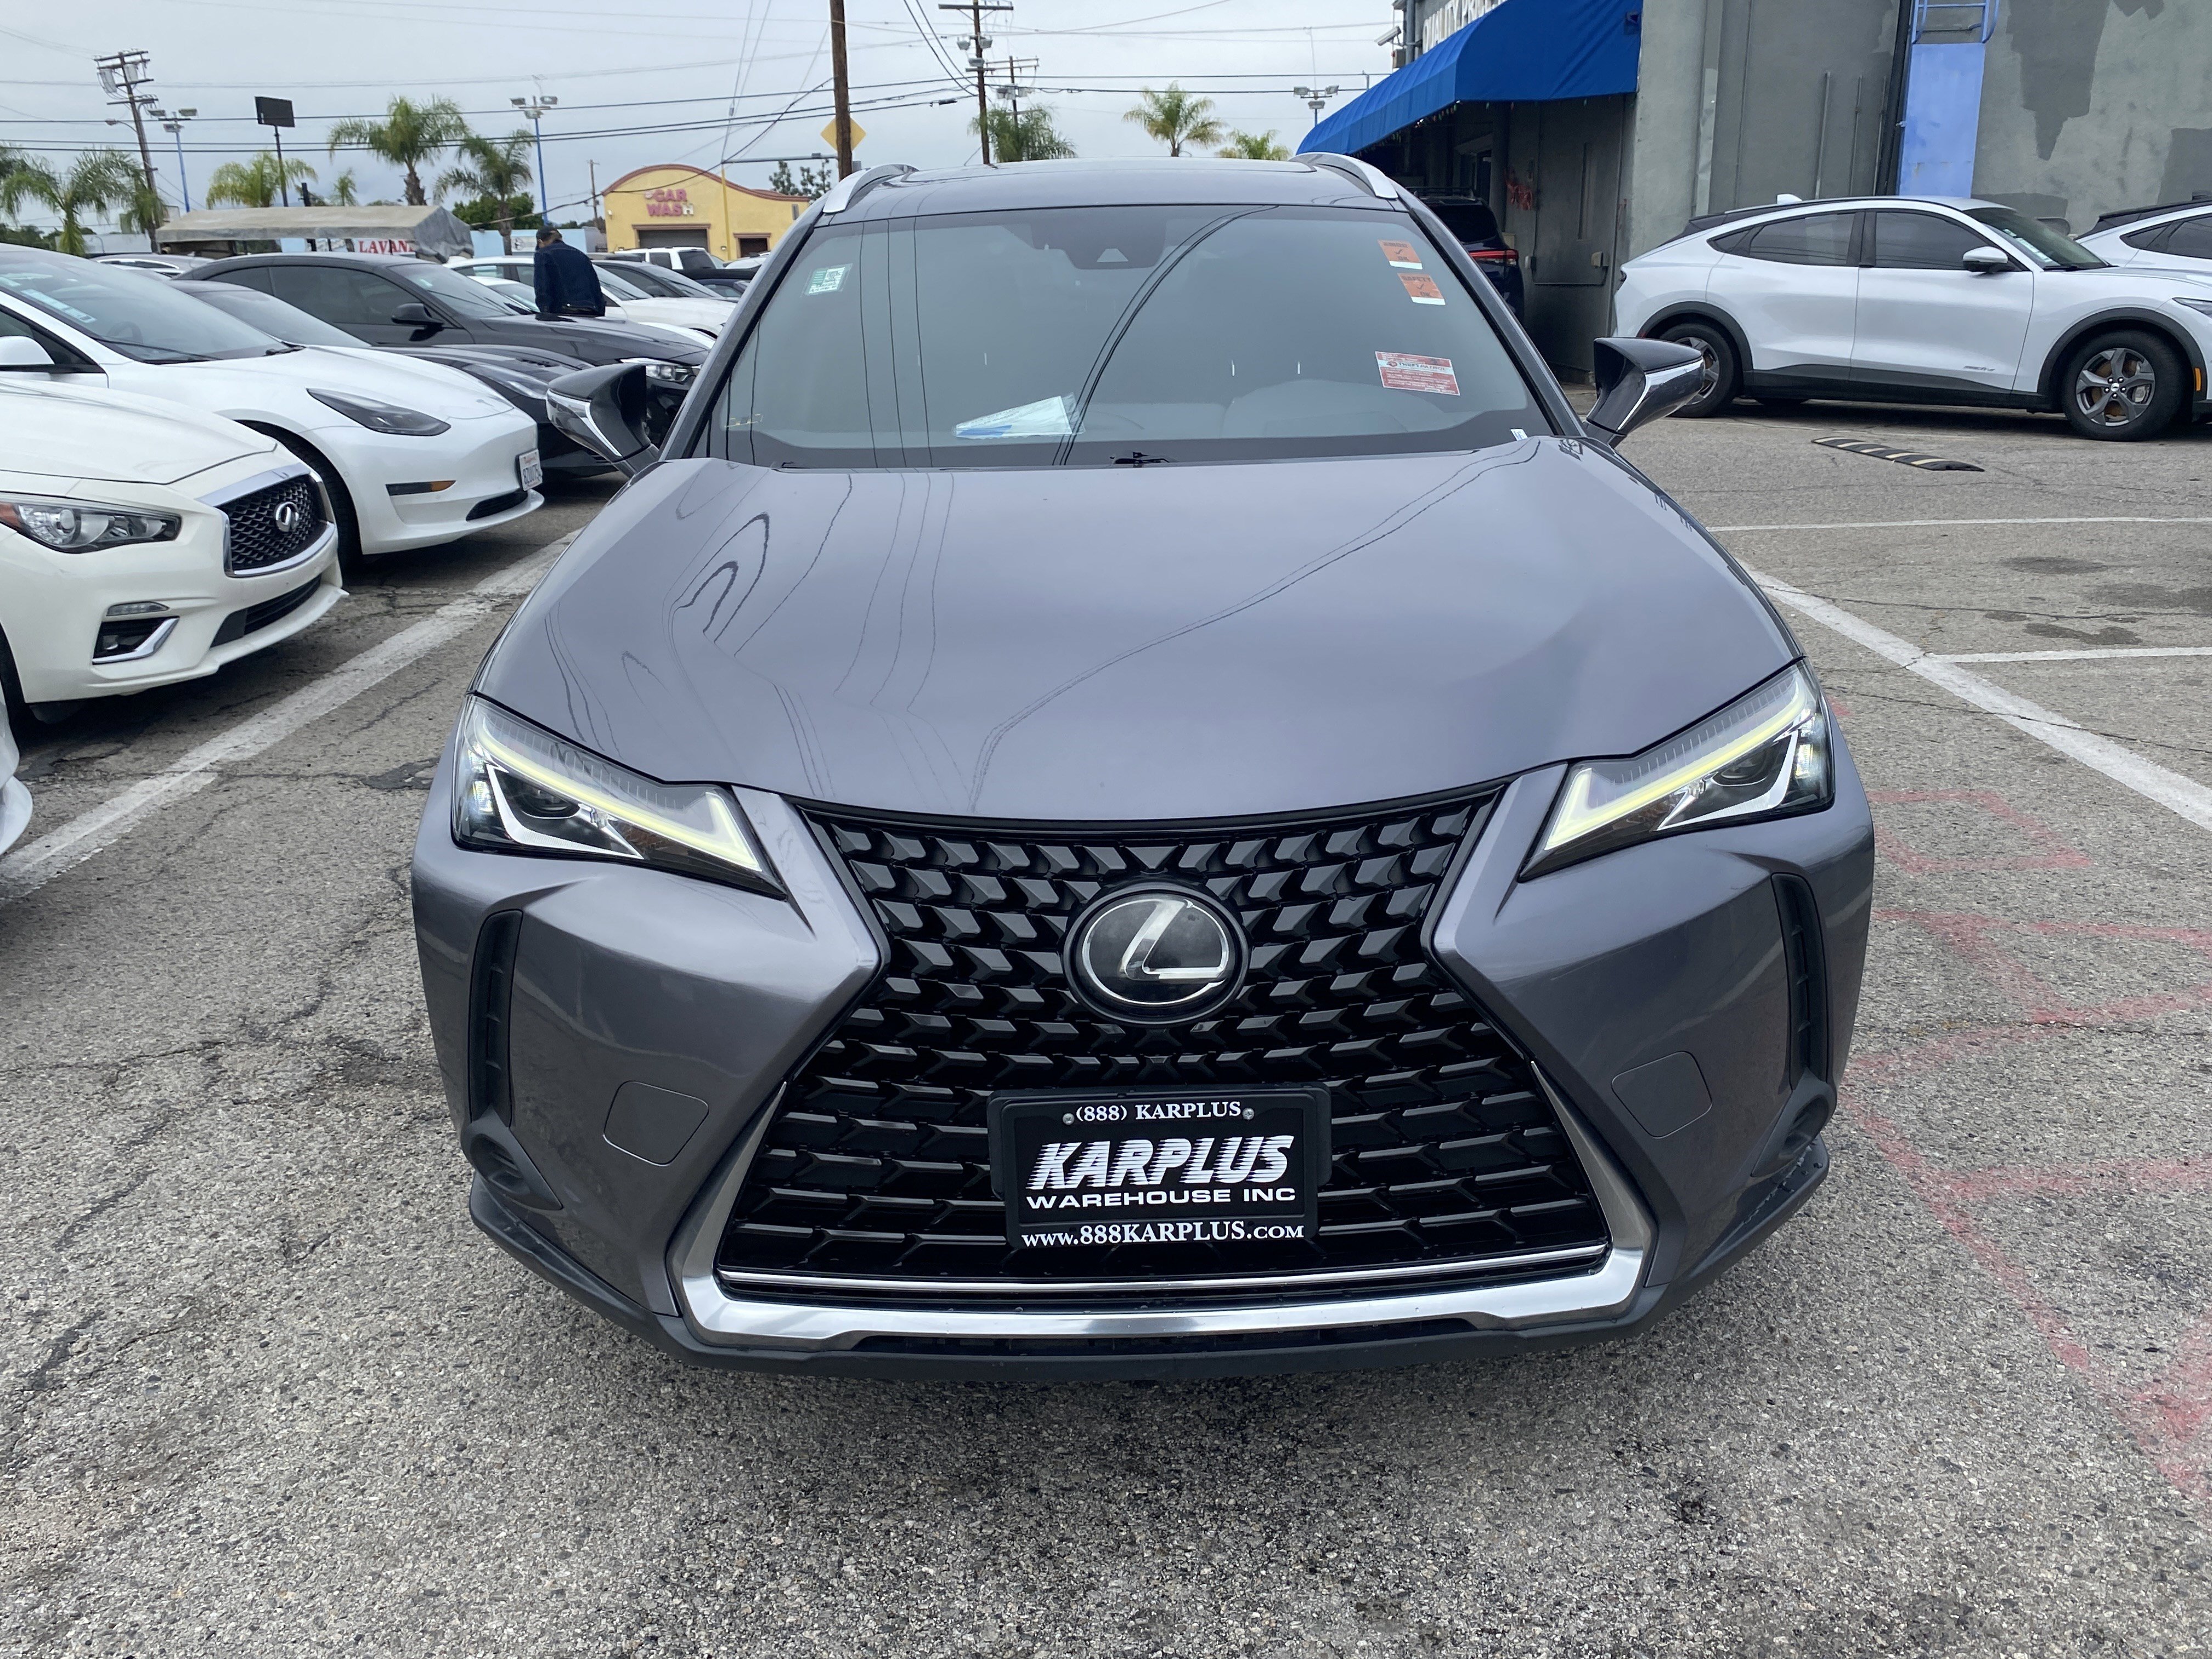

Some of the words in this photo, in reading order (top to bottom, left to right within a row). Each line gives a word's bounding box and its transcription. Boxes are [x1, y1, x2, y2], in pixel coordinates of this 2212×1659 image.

[1423, 0, 1461, 54] QUALITY
[653, 188, 687, 202] CAR
[646, 202, 693, 216] WASH
[359, 240, 415, 254] LAVAN
[1076, 1105, 1127, 1121] (888)
[1135, 1101, 1241, 1120] KARPLUS
[1025, 1135, 1294, 1190] KARPLUS
[1026, 1189, 1231, 1210] WAREHOUSE
[1243, 1188, 1296, 1201] INC
